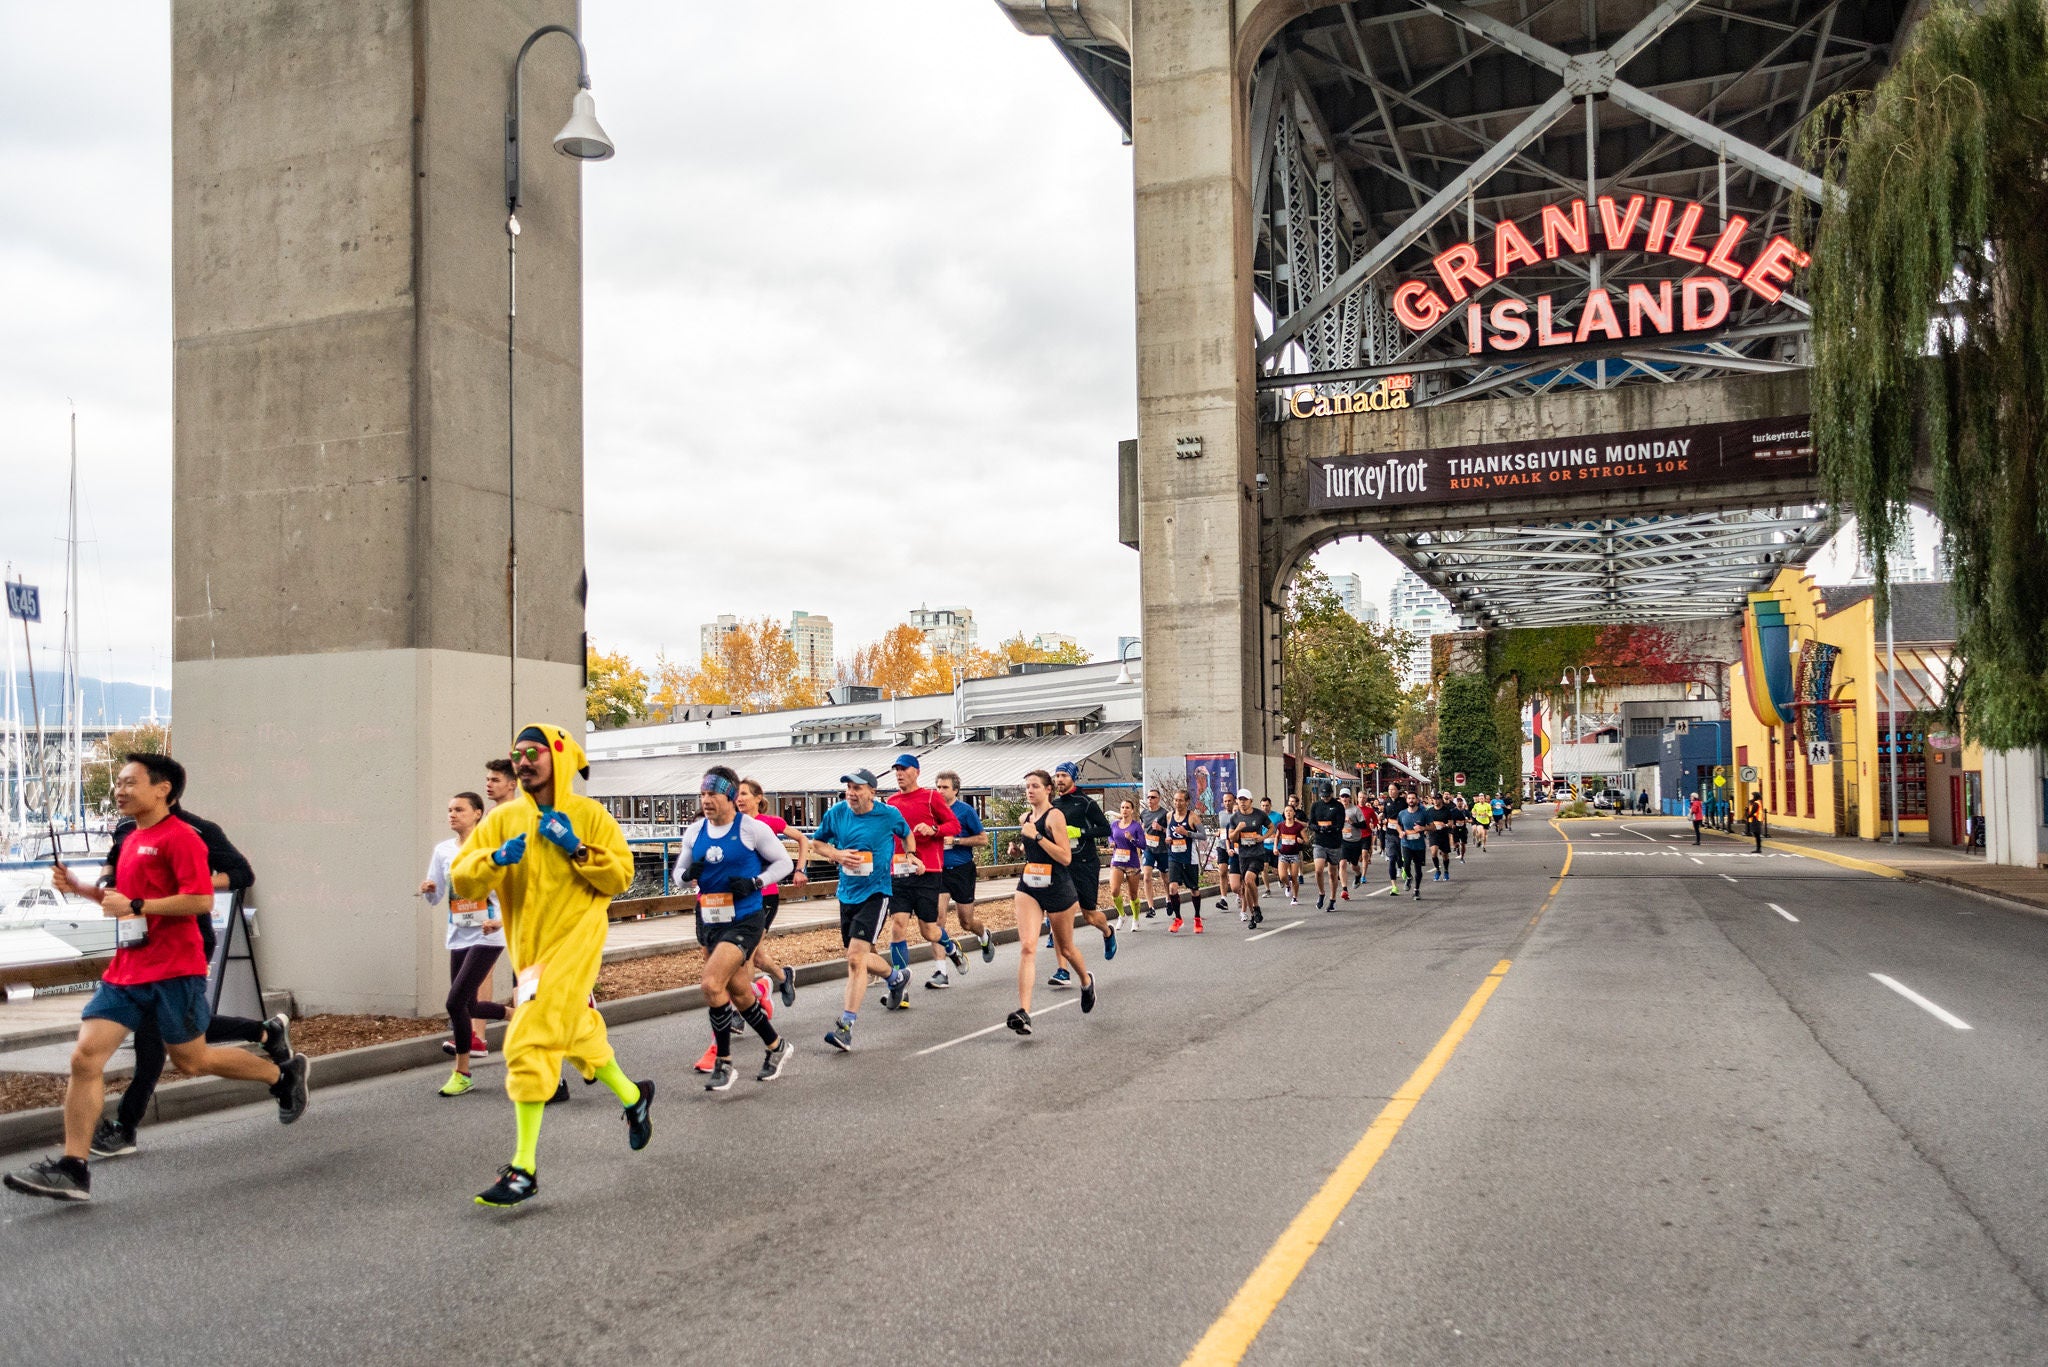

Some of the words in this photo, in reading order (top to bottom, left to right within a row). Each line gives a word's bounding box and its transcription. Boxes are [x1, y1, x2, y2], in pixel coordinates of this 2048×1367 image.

[1393, 194, 1812, 331] GRANVILLE
[1467, 276, 1731, 354] ISLAND
[1290, 379, 1410, 419] Canada
[1447, 447, 1597, 476] THANKSGIVING
[1605, 439, 1691, 463] MONDAY
[1549, 470, 1572, 482] OR
[1578, 463, 1647, 479] STROLL
[1656, 460, 1689, 473] 10K
